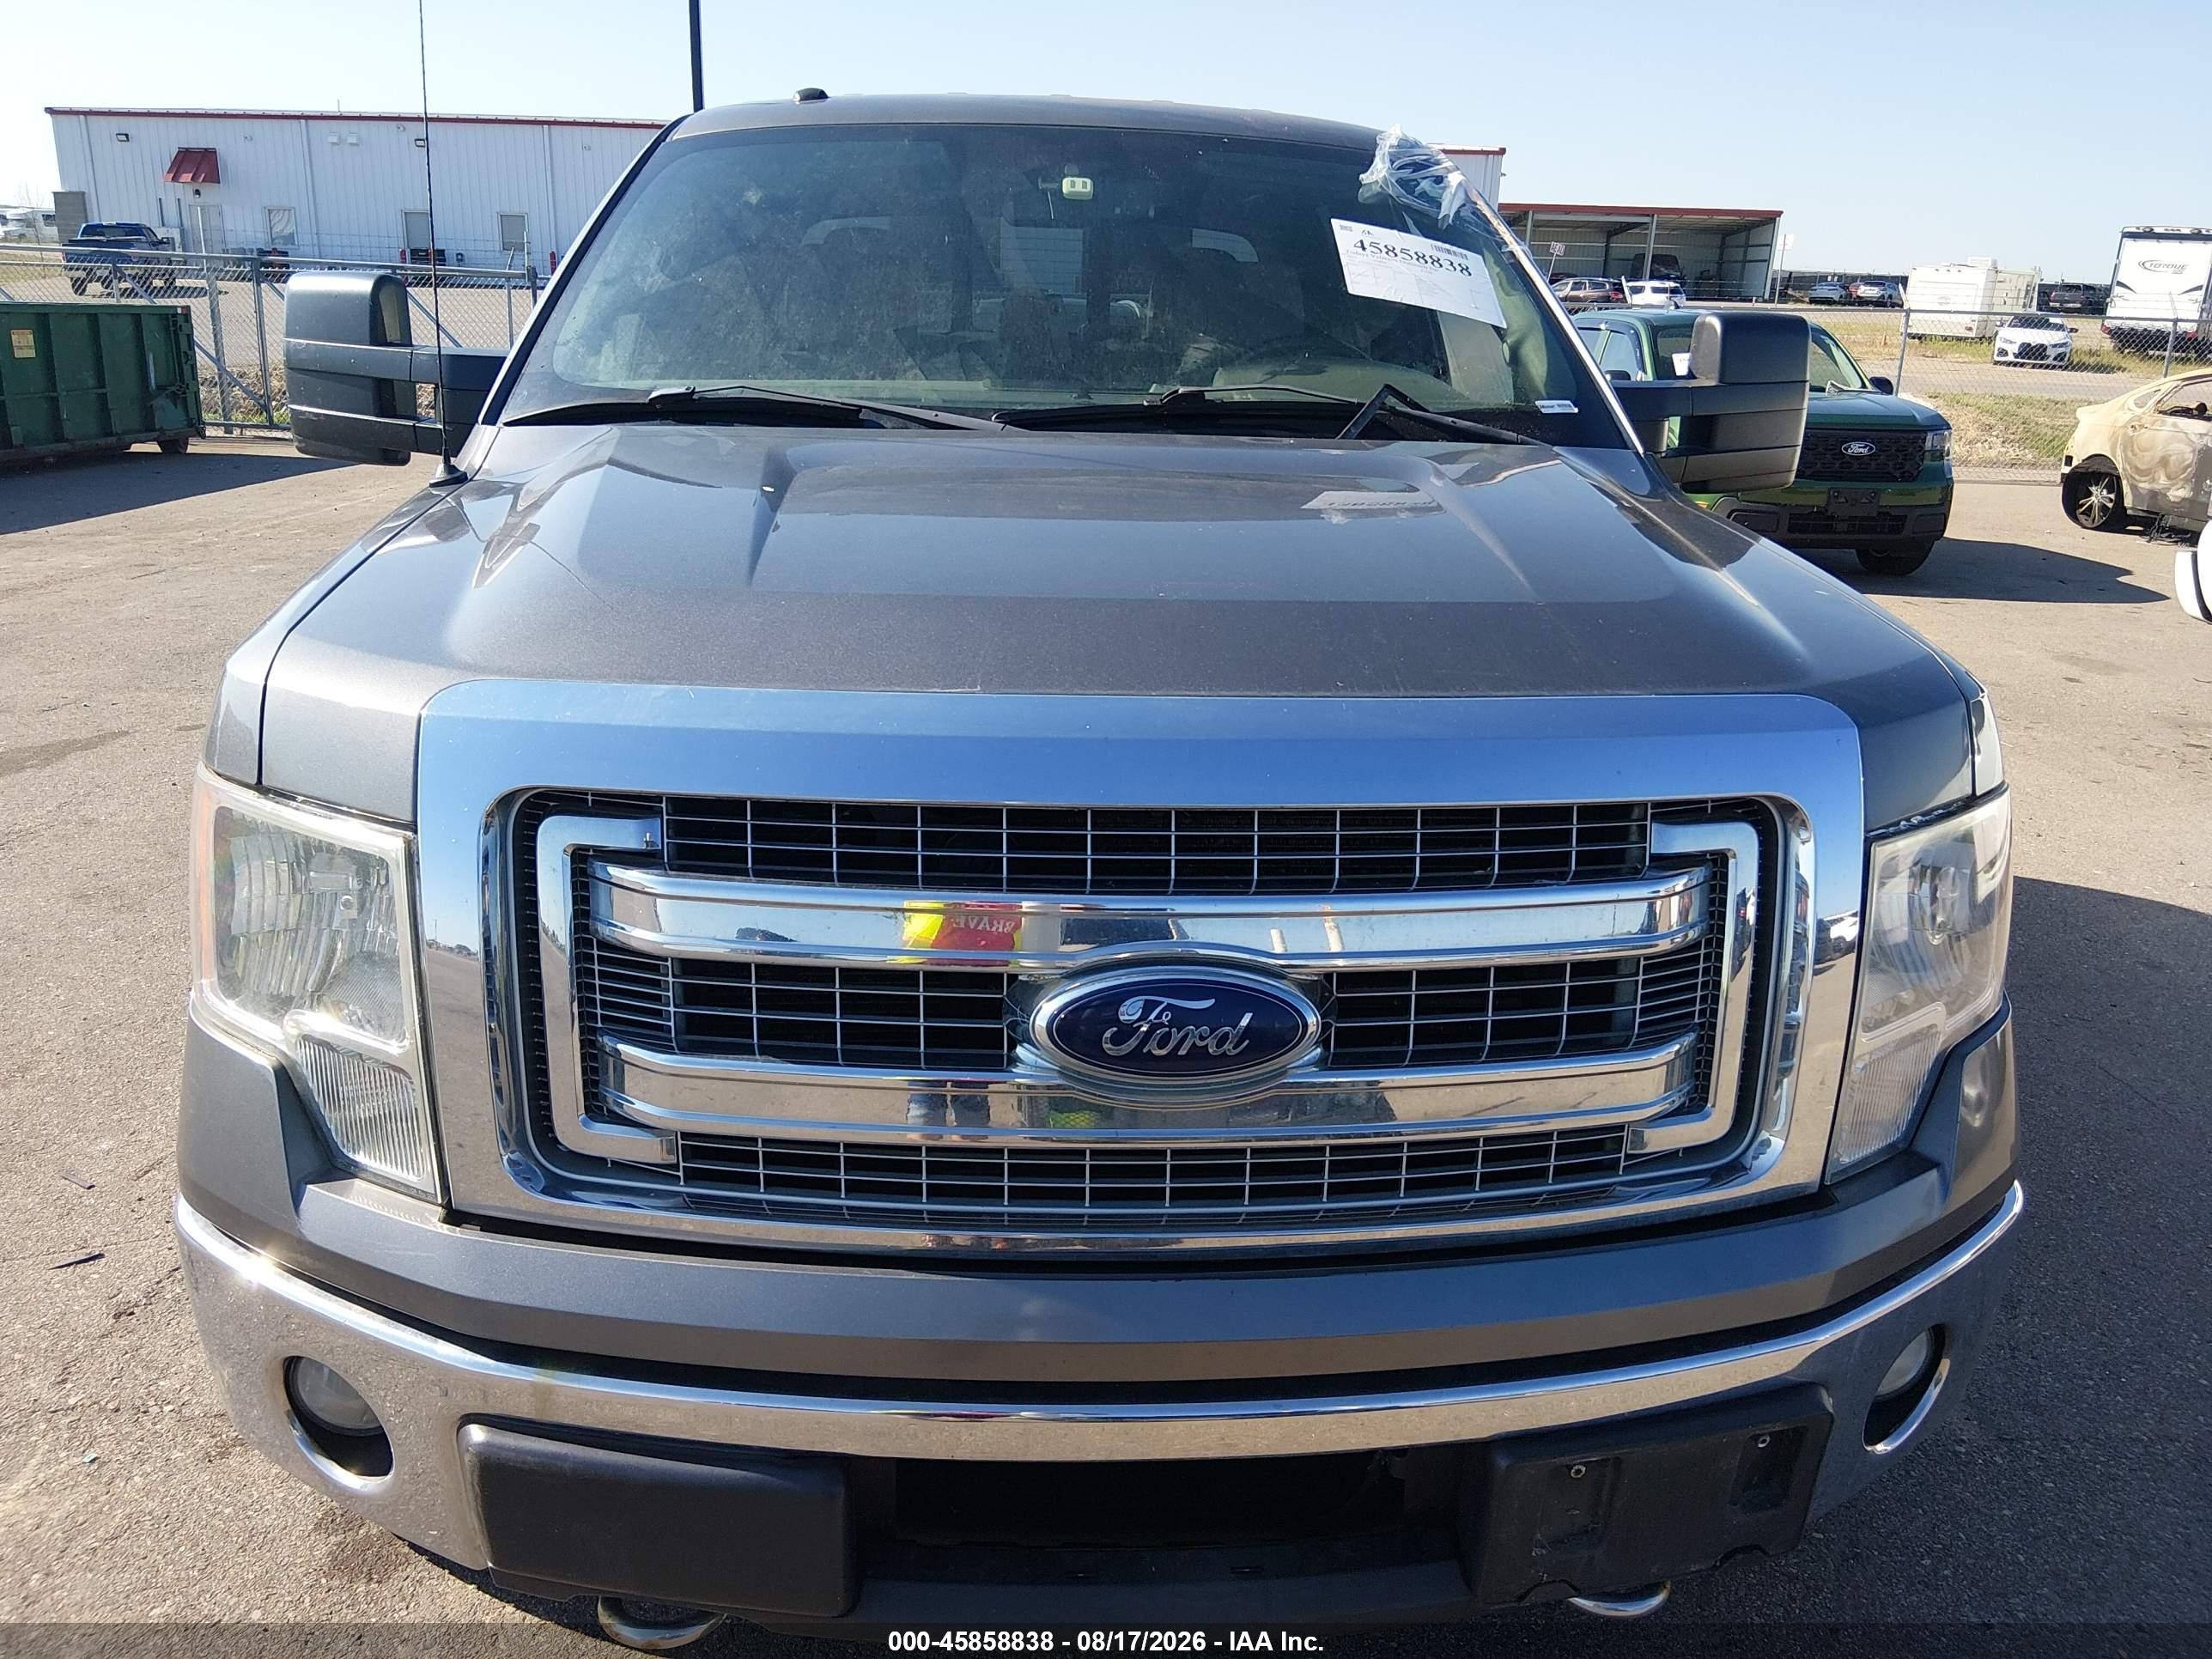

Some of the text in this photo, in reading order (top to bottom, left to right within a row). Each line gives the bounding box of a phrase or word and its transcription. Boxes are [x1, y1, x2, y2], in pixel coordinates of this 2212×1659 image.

[1353, 239, 1473, 277] 45858838
[1848, 443, 1870, 453] Ford
[1101, 994, 1254, 1058] Ford
